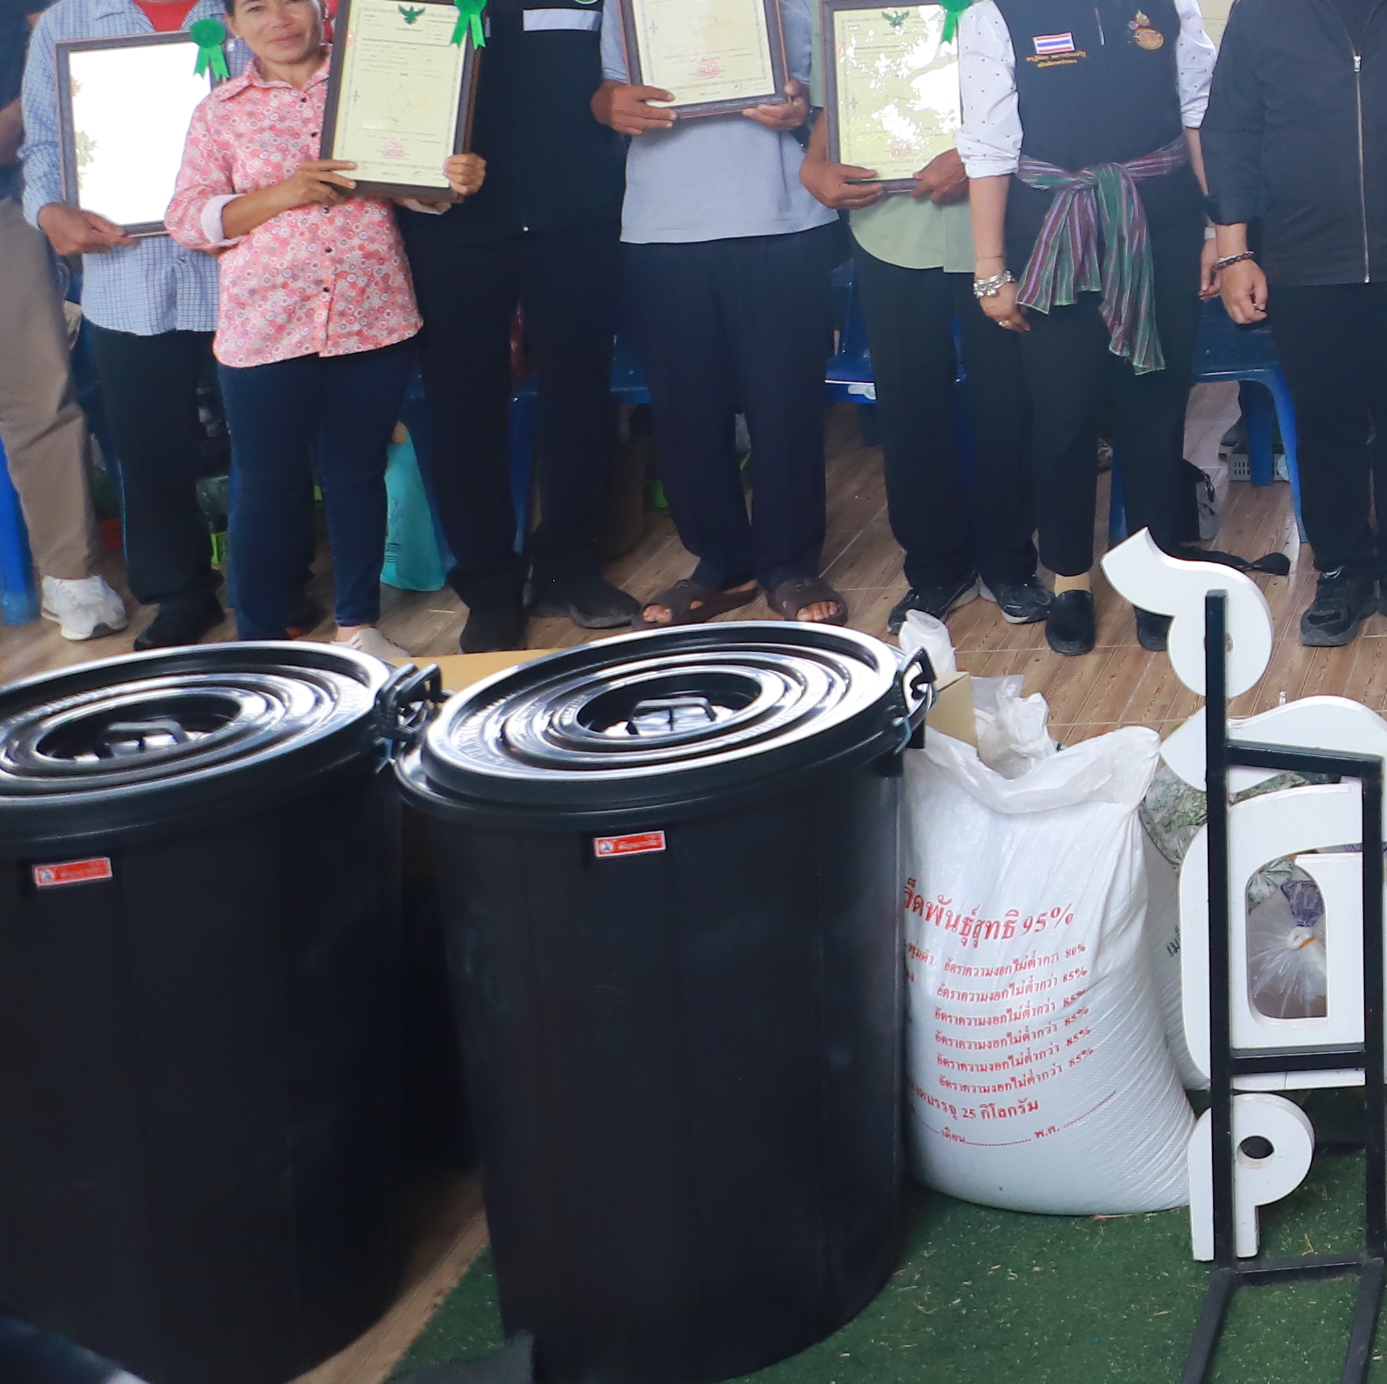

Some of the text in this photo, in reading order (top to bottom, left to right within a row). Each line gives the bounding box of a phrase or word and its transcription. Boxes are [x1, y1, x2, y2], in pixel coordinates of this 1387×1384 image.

[1021, 902, 1075, 937] 95%
[1065, 943, 1087, 960] 80%
[1066, 1026, 1092, 1047] 85%
[1068, 1047, 1095, 1068] 85%
[961, 1106, 977, 1120] 25
[981, 1097, 1040, 1120] กิโลกรัม
